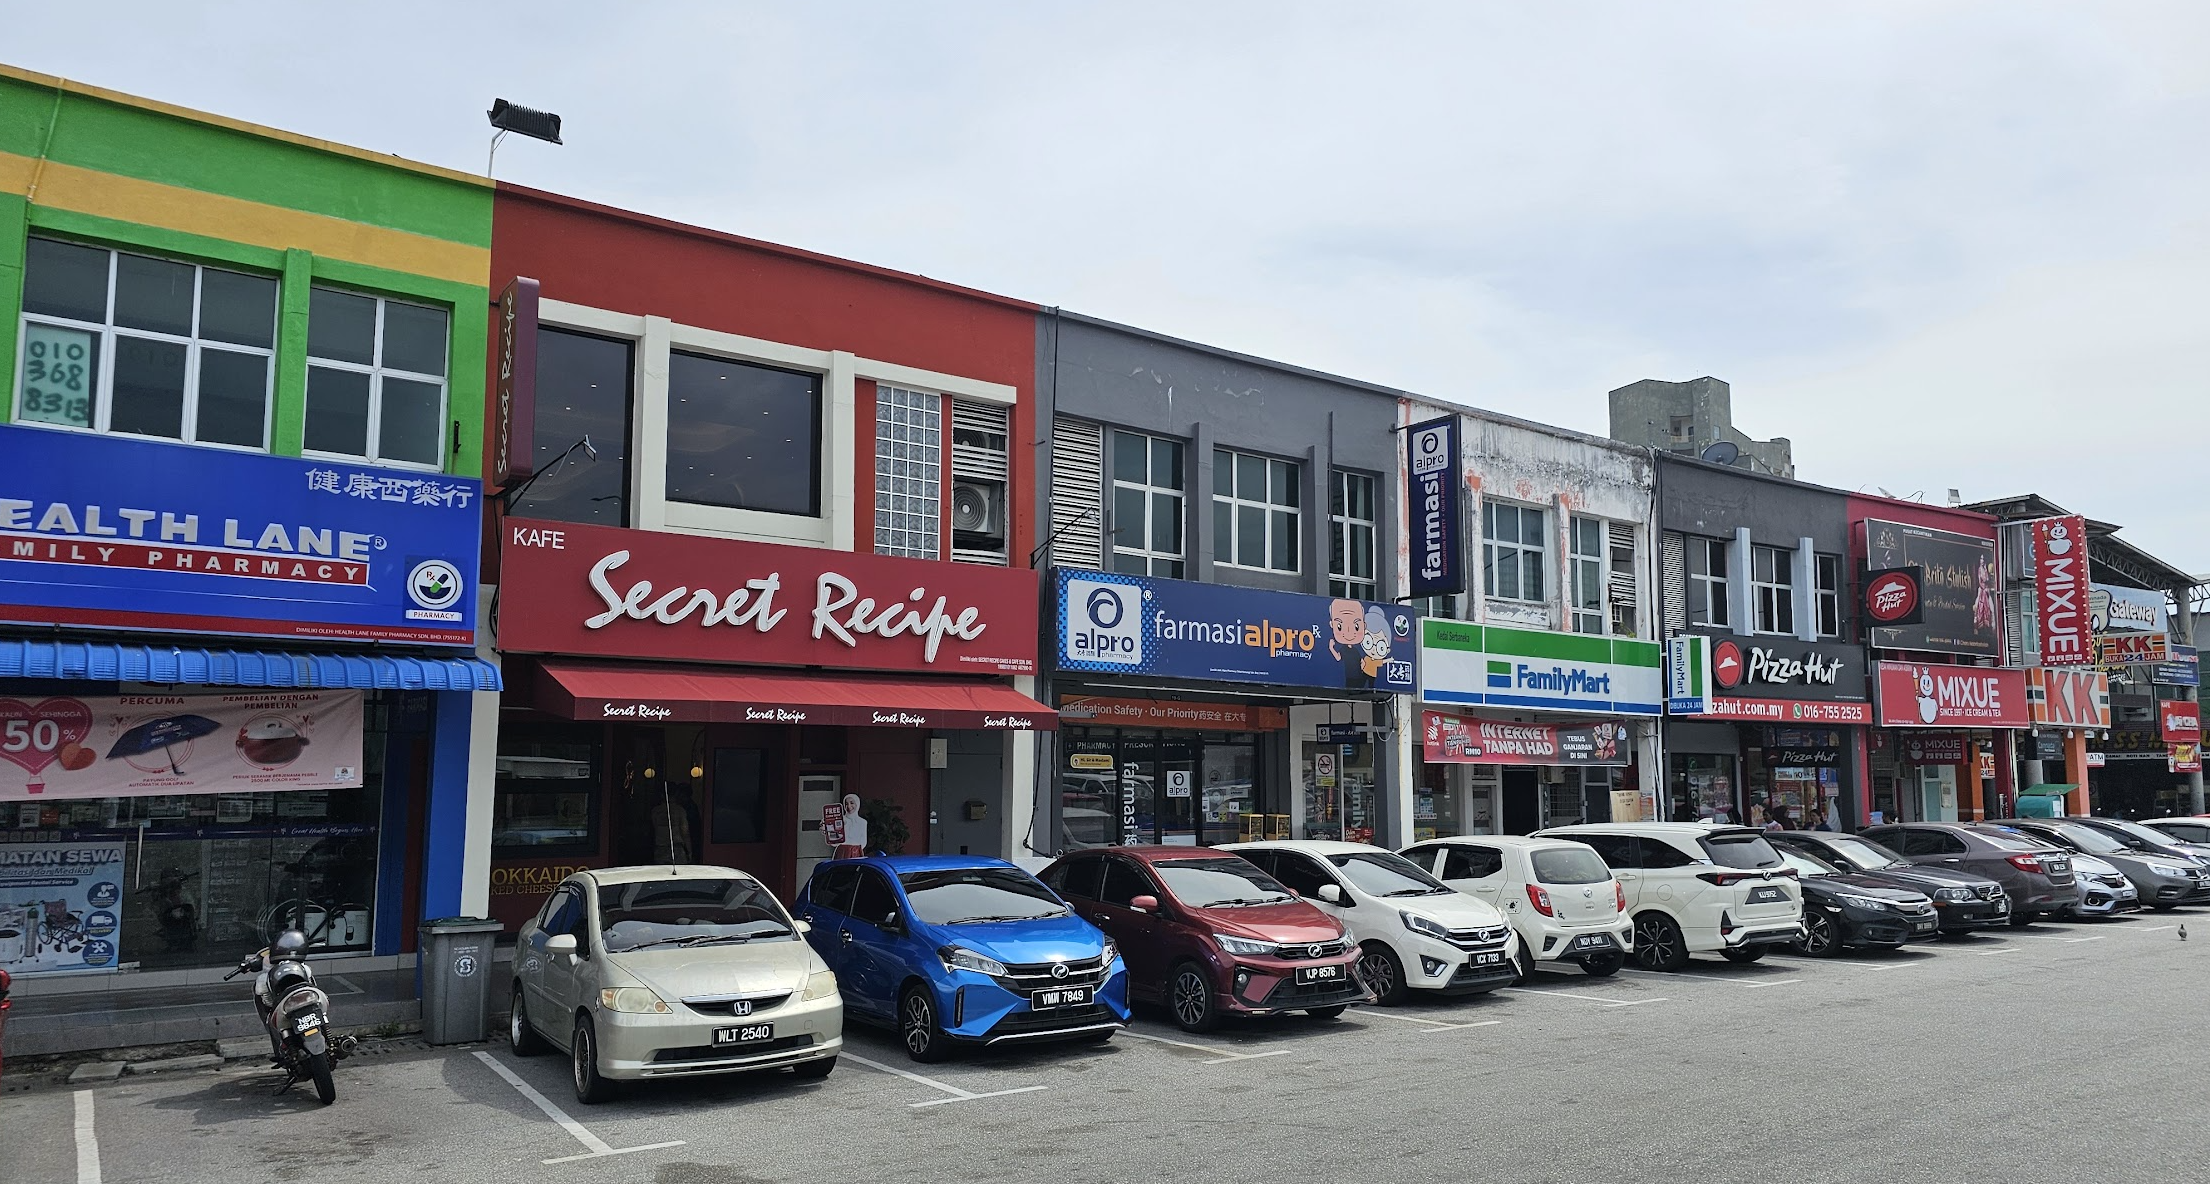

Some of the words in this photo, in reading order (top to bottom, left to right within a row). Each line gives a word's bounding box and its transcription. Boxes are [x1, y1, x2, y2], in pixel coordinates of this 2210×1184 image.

[501, 291, 515, 380] Recipe
[30, 341, 84, 361] 010
[28, 363, 84, 390] 368
[24, 388, 88, 422] 8313
[497, 387, 511, 473] Secret
[1416, 454, 1444, 471] alpro
[305, 467, 473, 509] 健康西藥行
[1420, 472, 1441, 581] farmasi
[225, 519, 371, 562] LANE
[512, 527, 565, 549] KAFE
[148, 550, 361, 581] PHARMACY
[585, 550, 787, 633] Secret
[812, 571, 987, 662] Recipe
[1876, 592, 1906, 608] Pizza
[1881, 599, 1903, 612] Hut
[2044, 558, 2079, 653] MIXUE
[413, 611, 455, 620] PHARMACY
[2110, 600, 2157, 626] Gateway
[1156, 610, 1242, 648] farmasi
[1244, 620, 1315, 658] alpro
[1075, 628, 1134, 658] alpro
[2116, 635, 2152, 654] KK
[1101, 652, 1133, 660] pharmacy
[1276, 648, 1312, 660] pharmacy
[2105, 654, 2124, 663] BUKA
[2124, 653, 2144, 661] 24
[2145, 652, 2164, 660] JAM
[1676, 641, 1685, 694] FamilyMart
[1748, 646, 1804, 683] Pizza
[1804, 652, 1844, 684] Hut
[1517, 664, 1610, 695] FamilyMart
[1937, 675, 2001, 708] MIXUE
[2044, 670, 2099, 725] KK
[120, 697, 185, 705] PERCUMA
[603, 702, 636, 718] Secret
[638, 703, 671, 720] Recipe
[746, 706, 773, 721] Secret
[775, 708, 806, 723] Recipe
[872, 710, 896, 724] Secret
[898, 711, 926, 726] Recipe
[1114, 705, 1143, 718] Safety
[1150, 707, 1165, 717] Our
[1167, 707, 1199, 721] Priority
[1804, 705, 1840, 719] 016-755
[1841, 707, 1862, 720] 2525
[1940, 708, 1953, 716] SINCE
[1993, 709, 2001, 717] TEA
[984, 715, 1006, 727] Secret
[1007, 716, 1032, 729] Recipe
[1480, 722, 1552, 740] INTERNET
[1465, 748, 1481, 756] RM10
[1483, 739, 1525, 755] TANPA
[1526, 741, 1554, 755] HAD
[1563, 743, 1593, 751] GANJARAN
[1926, 740, 1960, 749] MIXUE
[1782, 750, 1813, 763] Pizza
[1814, 751, 1838, 762] Hut
[1122, 762, 1139, 830] farmasi
[1169, 786, 1188, 796] alpro
[66, 849, 123, 863] SEWA
[54, 866, 91, 875] Medikal
[1305, 968, 1317, 981] VJP
[1319, 966, 1336, 978] 8576
[1042, 992, 1060, 1006] VMW
[1062, 989, 1084, 1002] 7849
[719, 1028, 738, 1042] WLT
[741, 1025, 769, 1040] 2540
